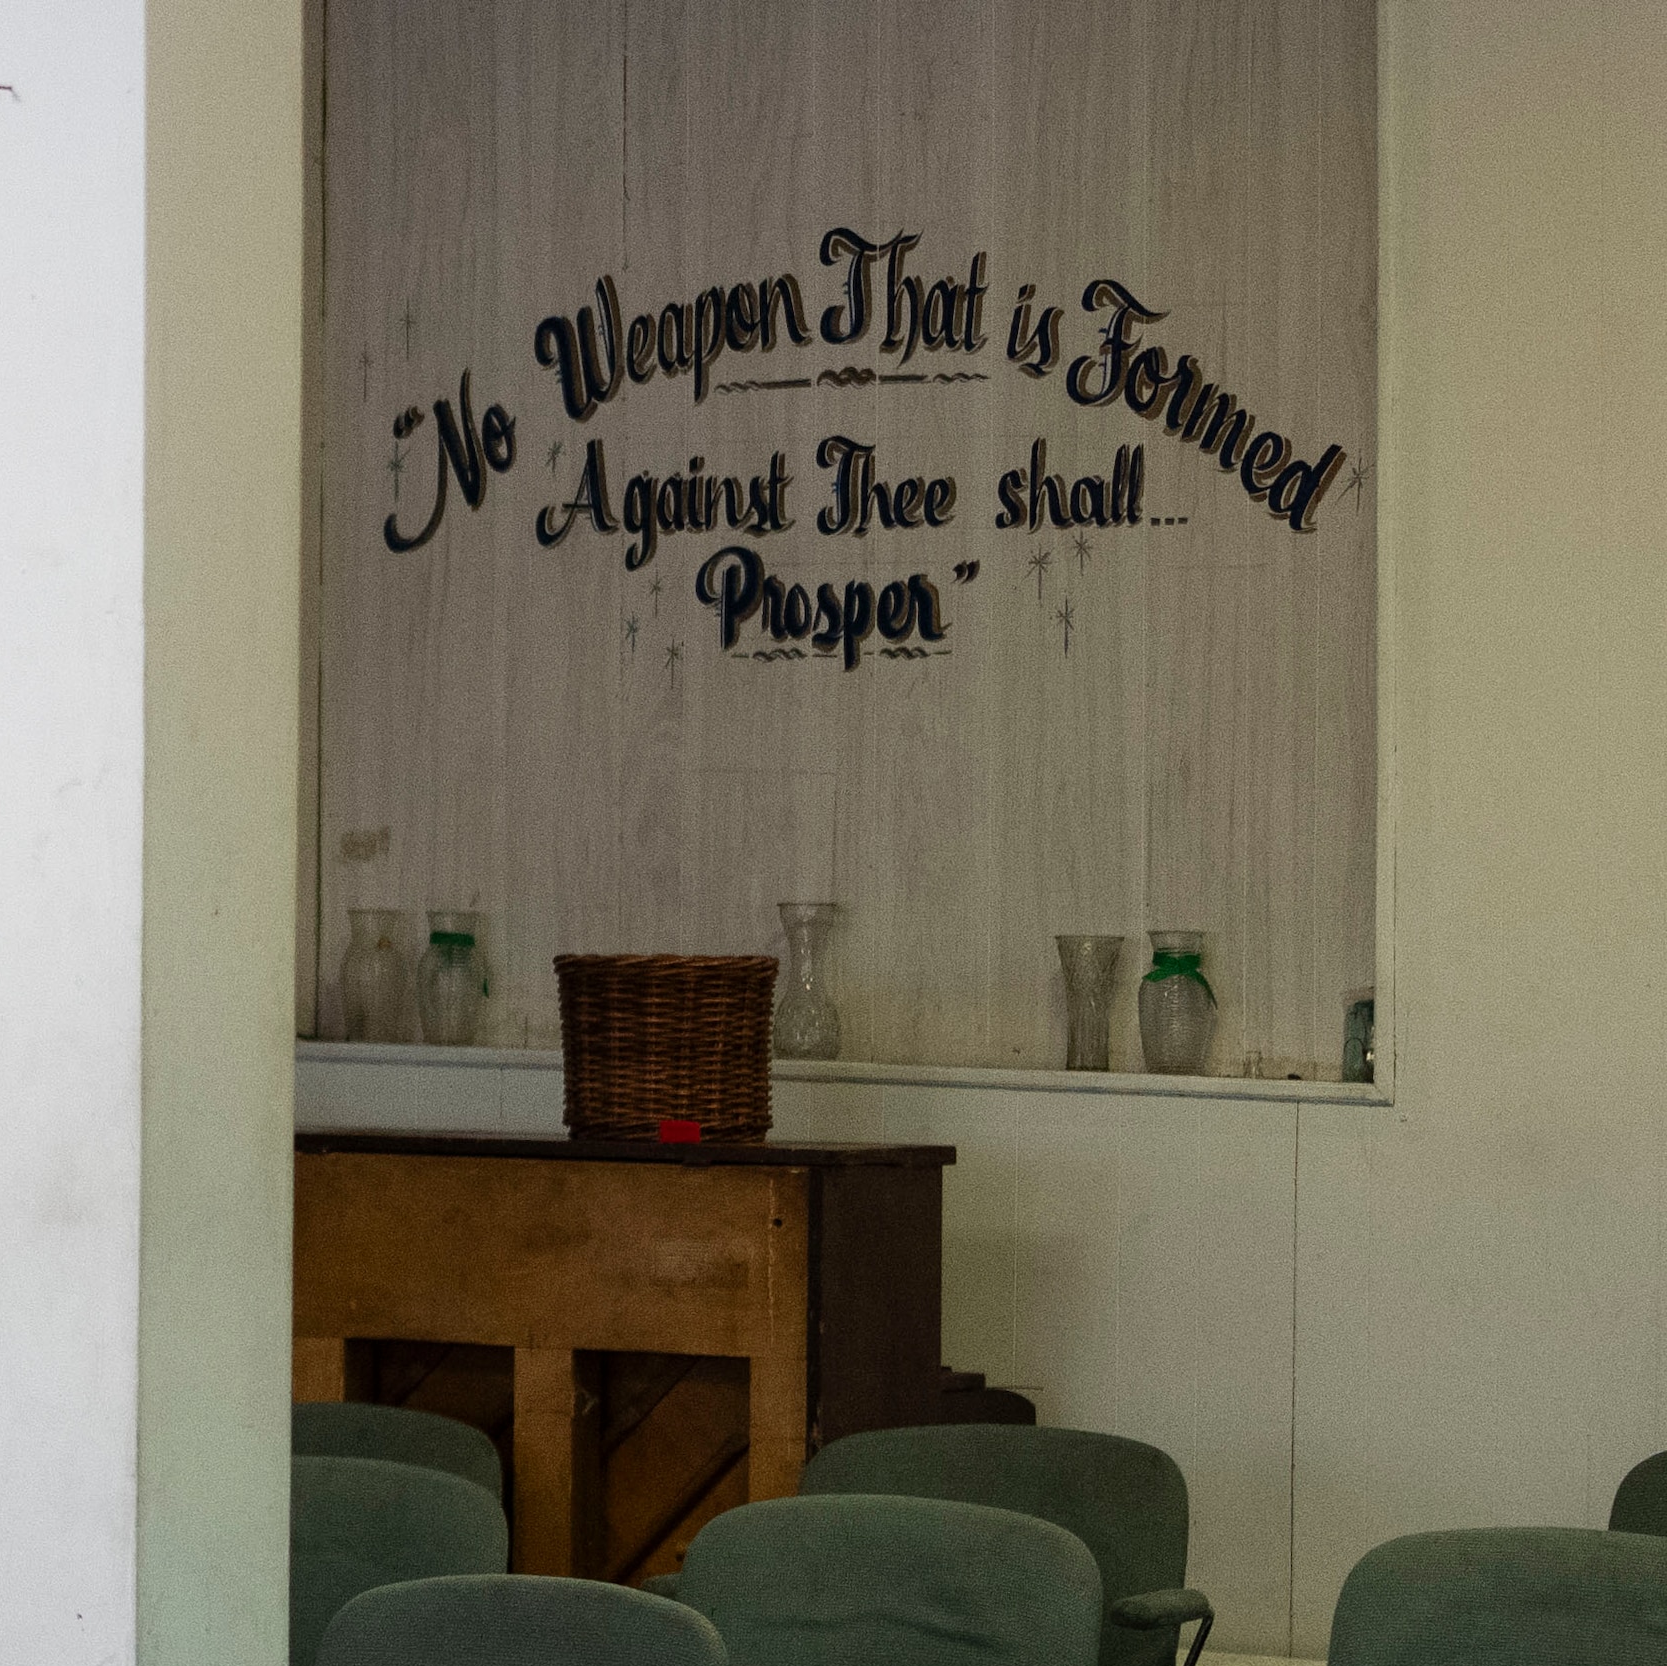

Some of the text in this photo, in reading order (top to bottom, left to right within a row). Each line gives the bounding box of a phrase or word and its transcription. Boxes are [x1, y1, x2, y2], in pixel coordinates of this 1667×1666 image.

[534, 274, 813, 424] Weapon
[818, 226, 990, 368] That
[1005, 283, 1065, 379] is
[1066, 278, 1347, 534] Formed
[534, 437, 797, 572] Against
[815, 434, 958, 538] Thee
